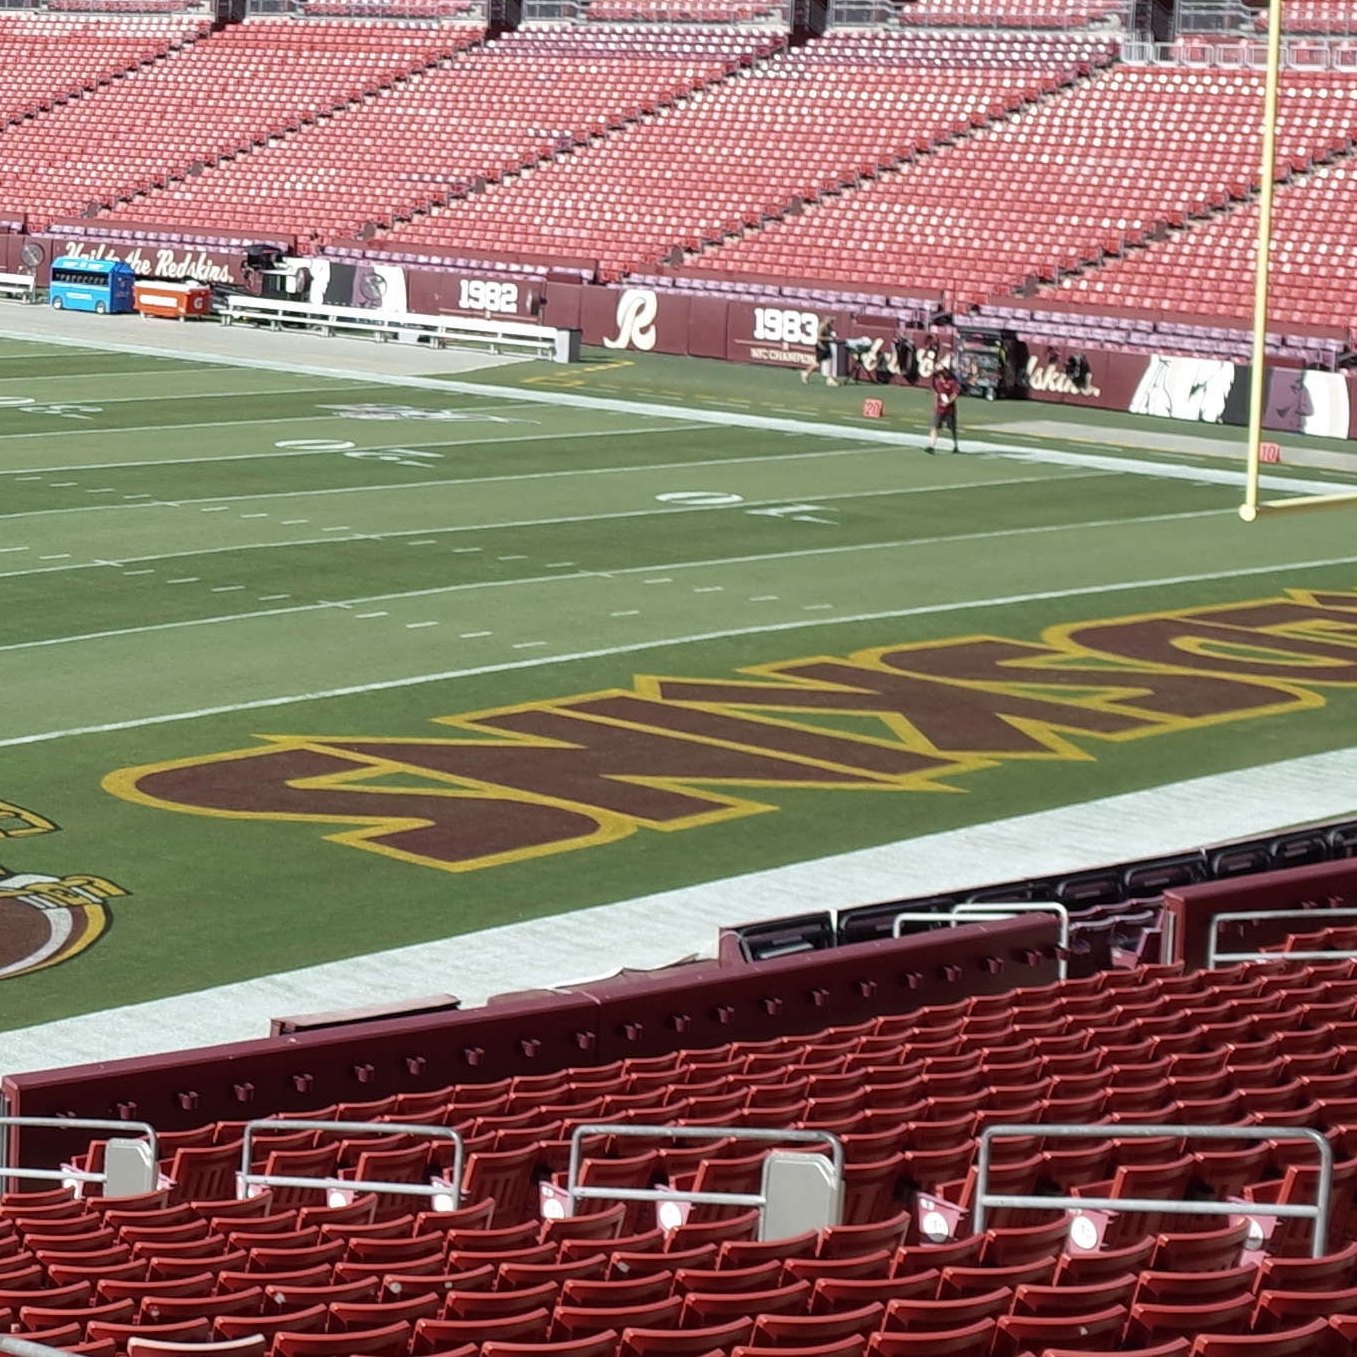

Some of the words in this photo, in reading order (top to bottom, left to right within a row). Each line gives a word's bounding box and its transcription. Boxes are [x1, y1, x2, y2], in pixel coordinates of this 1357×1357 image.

[155, 249, 235, 284] Redskins.
[458, 279, 519, 314] 1982
[603, 288, 658, 351] R
[753, 307, 820, 346] 1983
[768, 349, 817, 366] CHAMPION
[866, 400, 882, 418] 20
[1261, 444, 1277, 461] 10
